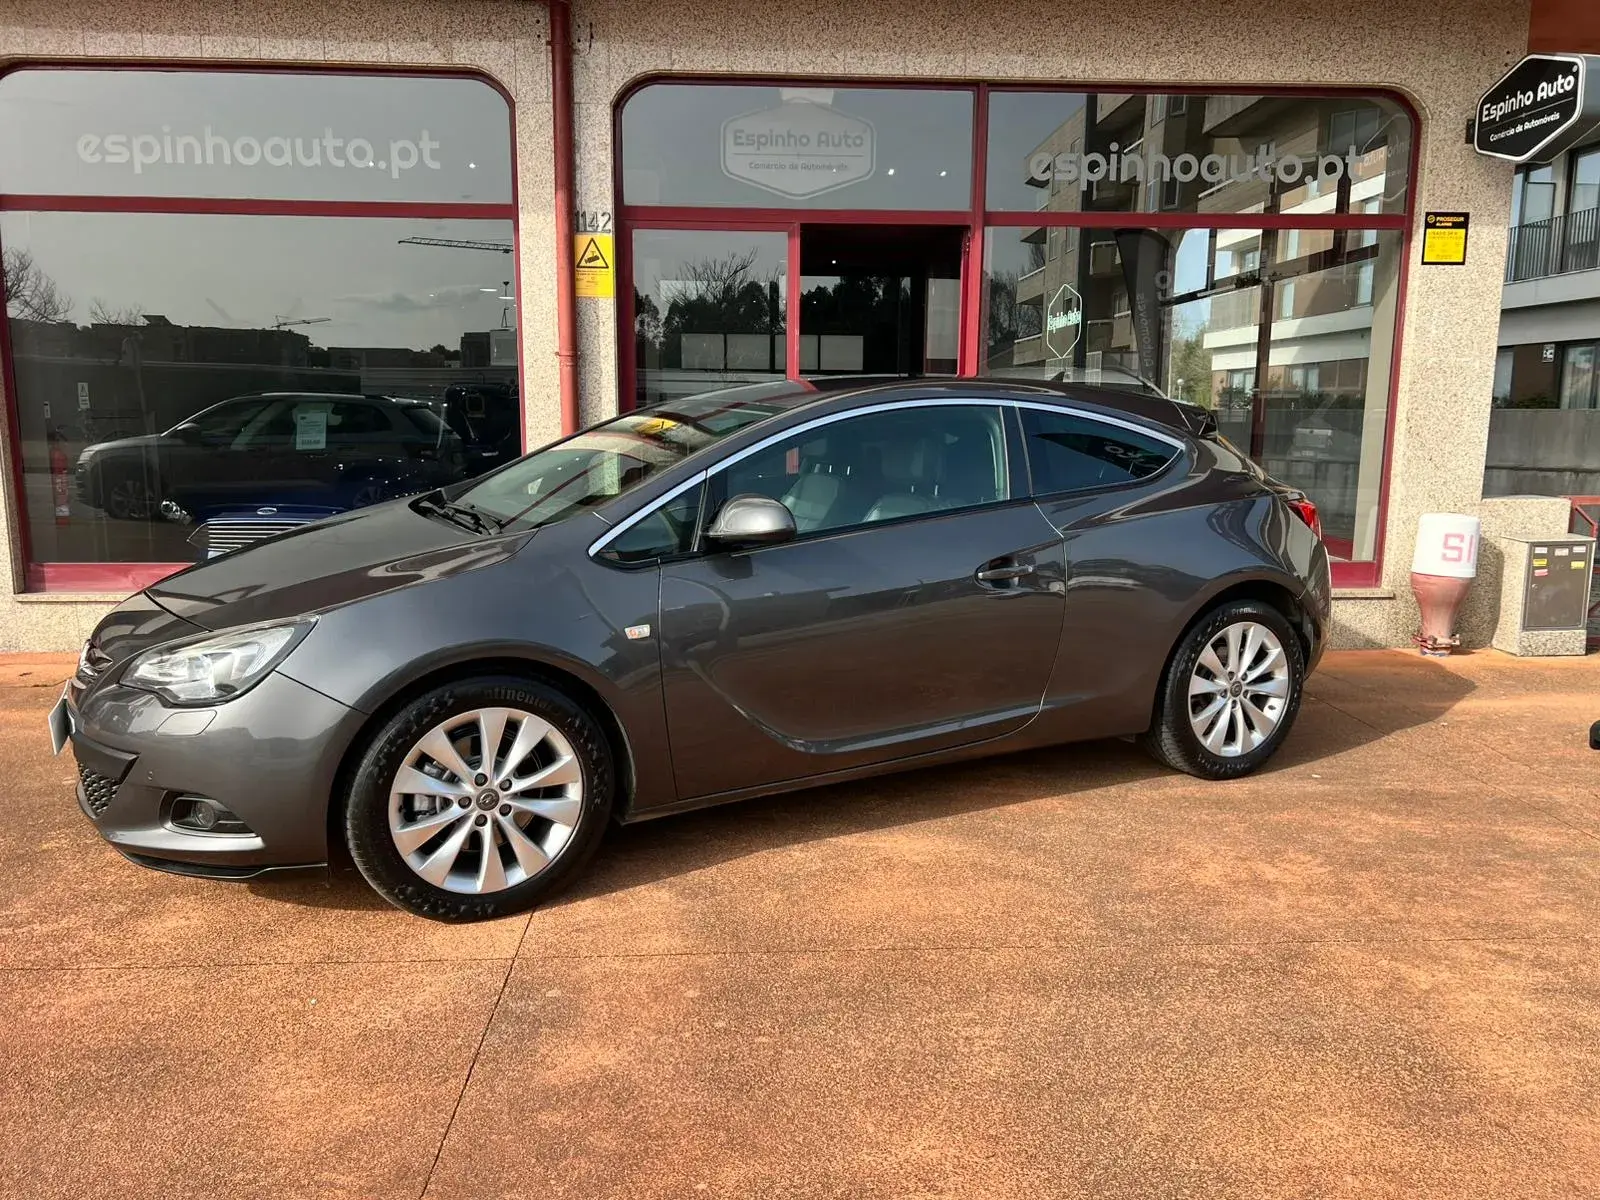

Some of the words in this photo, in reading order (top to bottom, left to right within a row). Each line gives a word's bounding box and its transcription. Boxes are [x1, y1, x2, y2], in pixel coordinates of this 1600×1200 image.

[1482, 91, 1533, 122] Espinho
[1537, 75, 1575, 101] Auto
[733, 130, 810, 150] Espinho
[817, 131, 863, 147] Auto
[1515, 123, 1523, 134] de
[76, 125, 441, 179] espinhoauto.pt
[1029, 142, 1362, 191] espinhoauto.pt
[575, 210, 612, 233] 1142
